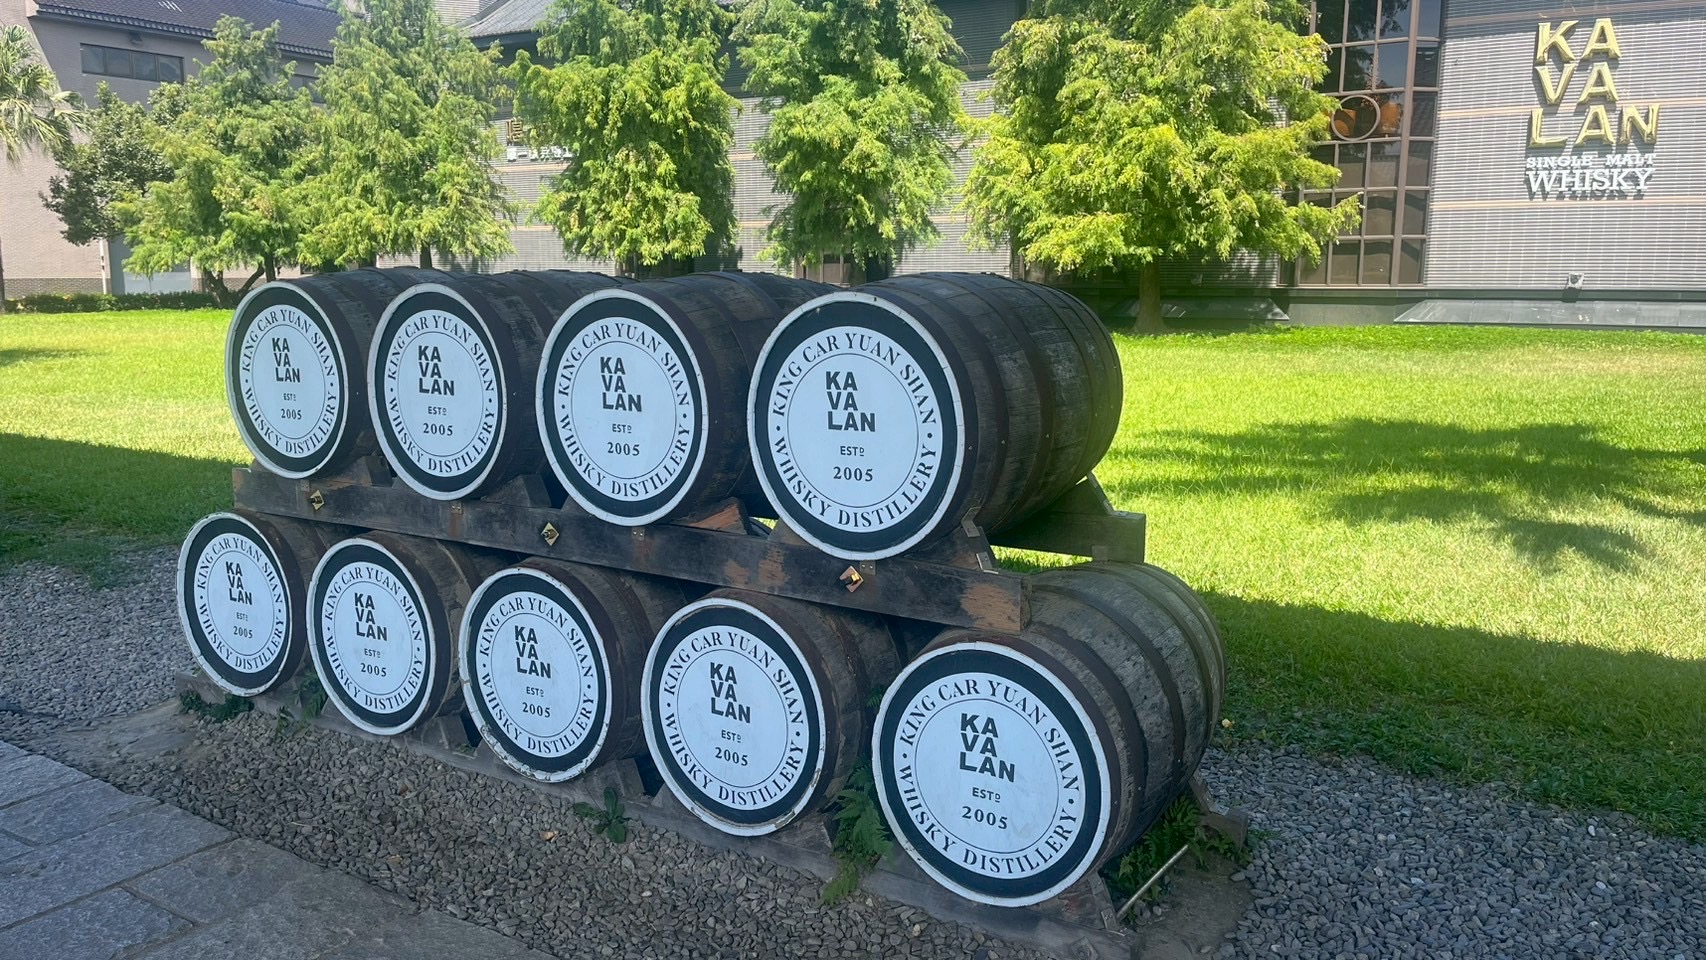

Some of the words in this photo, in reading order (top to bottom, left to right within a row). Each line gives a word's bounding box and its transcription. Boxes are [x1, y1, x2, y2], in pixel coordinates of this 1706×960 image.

[1536, 18, 1621, 63] KA
[1535, 62, 1618, 105] VA
[1529, 103, 1660, 147] LAN
[1526, 156, 1592, 168] SINGLE
[1606, 153, 1656, 166] MALT
[1526, 168, 1656, 192] WHISKY
[242, 331, 259, 372] KING
[257, 310, 278, 332] CAR
[280, 309, 311, 334] YUAN
[311, 332, 335, 377] SHAN
[272, 337, 290, 352] KA
[387, 336, 405, 380] KING
[405, 315, 429, 337] CAR
[432, 315, 471, 344] YUAN
[471, 343, 494, 391] SHAN
[418, 345, 441, 362] KA
[274, 353, 291, 367] VA
[419, 362, 442, 378] VA
[558, 347, 582, 397] KING
[582, 323, 611, 348] CAR
[615, 323, 661, 353] YUAN
[661, 352, 690, 405] SHAN
[600, 357, 626, 375] KA
[275, 367, 300, 383] LAN
[601, 375, 626, 393] VA
[773, 362, 802, 416] KING
[803, 335, 839, 363] CAR
[845, 333, 900, 366] YUAN
[900, 364, 936, 424] SHAN
[826, 371, 858, 391] KA
[419, 378, 454, 396] LAN
[602, 392, 642, 412] LAN
[827, 392, 858, 411] VA
[245, 387, 282, 446] WHISKY
[285, 391, 336, 454] DISTILLERY
[281, 408, 302, 420] 2005
[828, 411, 875, 432] LAN
[389, 397, 424, 463] WHISKY
[428, 409, 494, 473] DISTILLERY
[423, 423, 453, 436] 2005
[560, 415, 606, 487] WHISKY
[611, 424, 690, 497] DISTILLERY
[607, 442, 640, 456] 2005
[774, 437, 832, 517] WHISKY
[838, 447, 936, 527] DISTILLERY
[833, 467, 873, 481] 2005
[197, 552, 213, 590] KING
[212, 537, 231, 554] CAR
[232, 538, 262, 562] YUAN
[262, 562, 282, 603] SHAN
[226, 562, 242, 576] KA
[228, 575, 243, 590] VA
[229, 588, 252, 605] LAN
[325, 582, 342, 621] KING
[341, 567, 363, 583] CAR
[366, 567, 400, 595] YUAN
[400, 595, 422, 641] SHAN
[355, 593, 375, 610] KA
[355, 608, 375, 624] VA
[200, 603, 232, 660] WHISKY
[235, 618, 284, 670] DISTILLERY
[233, 626, 253, 638] 2005
[356, 622, 387, 641] LAN
[479, 614, 500, 657] KING
[500, 597, 524, 616] CAR
[528, 597, 568, 628] YUAN
[567, 628, 593, 678] SHAN
[515, 625, 538, 644] KA
[516, 642, 538, 660] VA
[326, 635, 360, 698] WHISKY
[365, 659, 423, 709] DISTILLERY
[361, 663, 387, 677] 2005
[516, 658, 551, 679] LAN
[664, 649, 691, 696] KING
[691, 632, 722, 652] CAR
[727, 632, 774, 668] YUAN
[773, 669, 803, 724] SHAN
[710, 662, 737, 685] KA
[711, 680, 737, 702] VA
[481, 672, 523, 741] WHISKY
[528, 694, 594, 754] DISTILLERY
[522, 702, 550, 718] 2005
[711, 697, 750, 723] LAN
[900, 695, 936, 746] KING
[938, 679, 980, 701] CAR
[988, 680, 1047, 725] YUAN
[1044, 727, 1079, 791] SHAN
[961, 713, 999, 738] KA
[960, 733, 997, 757] VA
[665, 712, 712, 790] WHISKY
[719, 741, 803, 806] DISTILLERY
[715, 747, 748, 766] 2005
[960, 752, 1015, 783] LAN
[899, 765, 956, 852] WHISKY
[963, 809, 1077, 874] DISTILLERY
[962, 806, 1007, 829] 2005
